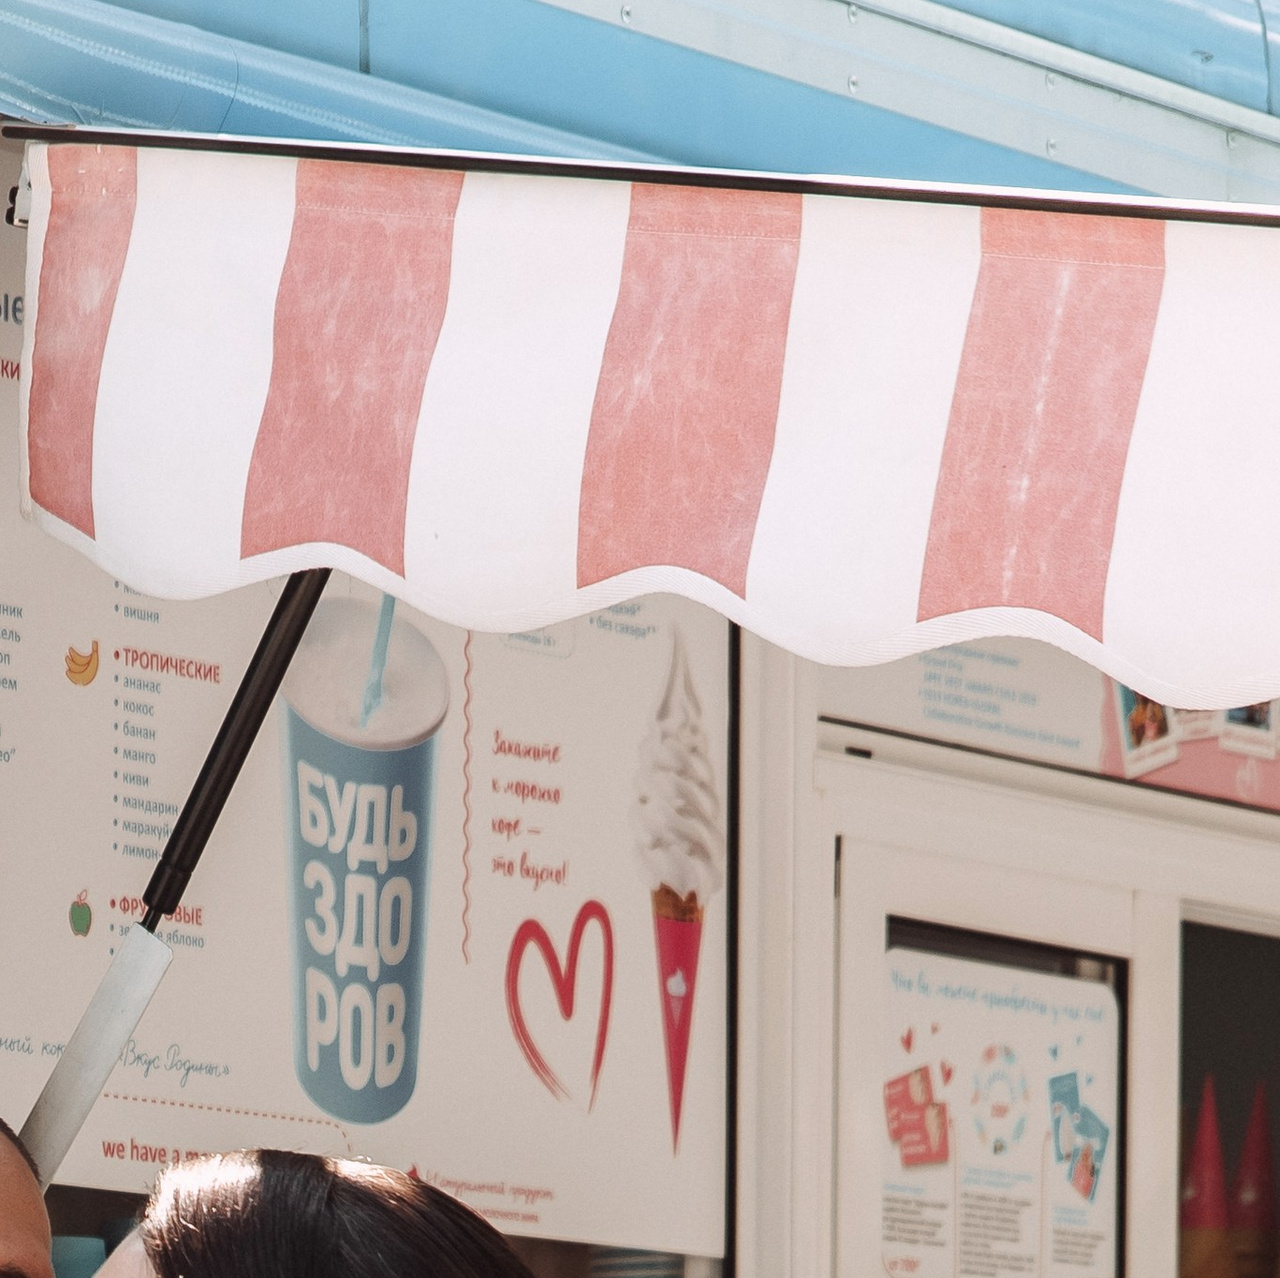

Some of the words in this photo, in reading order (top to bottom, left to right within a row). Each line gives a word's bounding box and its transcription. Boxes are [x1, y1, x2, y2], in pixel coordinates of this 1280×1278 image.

[123, 605, 160, 623] вишня
[123, 647, 221, 684] ТРОПИЧЕСКИЕ
[123, 675, 162, 694] ананас
[123, 700, 155, 717] кокос
[122, 720, 156, 741] банан
[122, 748, 157, 765] манго
[122, 772, 150, 787] киви
[122, 796, 179, 818] мандарин
[297, 758, 418, 875] БУДЬ
[122, 820, 173, 841] маракуй
[491, 818, 521, 842] кофе
[119, 896, 203, 926] ФРУВЫЕ
[303, 859, 413, 982] ЗДО
[166, 929, 205, 949] яблоко
[305, 966, 407, 1091] РОВ
[102, 1140, 126, 1160] we
[130, 1138, 167, 1164] have
[172, 1149, 181, 1165] a
